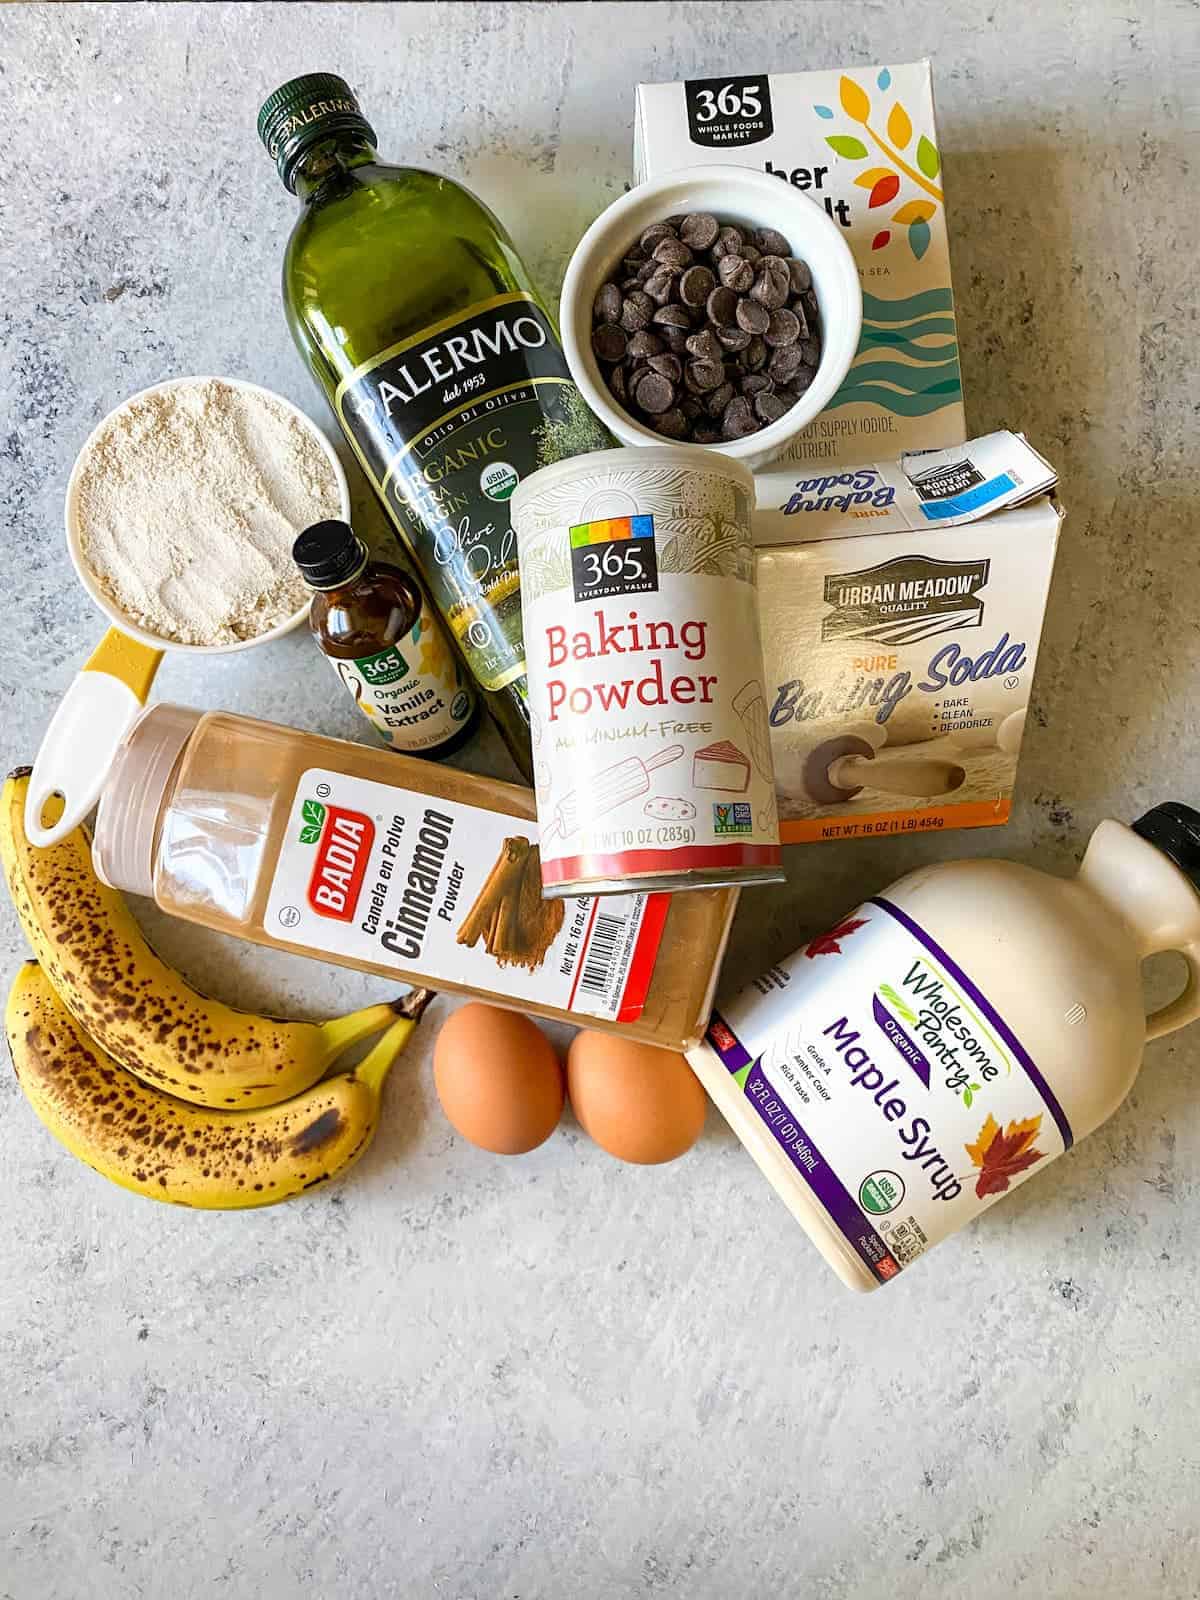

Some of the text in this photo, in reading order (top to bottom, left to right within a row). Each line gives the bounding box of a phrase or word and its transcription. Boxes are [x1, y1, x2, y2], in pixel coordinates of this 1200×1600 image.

[696, 84, 762, 122] 365
[697, 121, 764, 134] WHOLE FOODS
[712, 130, 751, 141] MARKET
[765, 161, 828, 190] her
[824, 197, 851, 227] lt
[443, 373, 486, 404] dal 1953
[820, 420, 858, 438] SUPPLY
[486, 468, 509, 485] USDA
[796, 470, 879, 495] Soda
[922, 470, 971, 490] MEADOW
[931, 479, 971, 497] URBAN
[779, 486, 896, 515] Baking
[434, 516, 496, 565] Olive
[463, 529, 514, 584] Oil
[579, 582, 653, 598] EVERYDAY VALUE
[839, 582, 896, 607] URBAN
[879, 601, 929, 614] QUALITY
[546, 611, 708, 668] Baking
[363, 654, 400, 677] 365
[852, 654, 898, 672] PURE
[917, 632, 1027, 692] Soda
[374, 680, 420, 699] Organic
[376, 688, 435, 715] Vanilla
[546, 659, 718, 722] Powder
[943, 698, 969, 708] BAKE
[384, 698, 445, 727] Extract
[940, 718, 993, 732] DEODORIZE
[941, 709, 973, 720] CLEAN
[622, 831, 633, 846] 10
[639, 829, 652, 843] OZ
[656, 826, 696, 845] (283g)
[822, 826, 840, 837] NET
[843, 825, 858, 835] WT
[863, 824, 873, 833] 16
[875, 822, 889, 832] OZ
[920, 817, 944, 827] 454g
[315, 817, 365, 913] BADIA
[361, 815, 406, 936] Canela en Polvo
[381, 808, 455, 960] Cinnamon
[438, 861, 465, 922] Powder
[560, 958, 574, 976] Net
[570, 926, 582, 939] 16
[902, 961, 999, 1082] Wholesome
[883, 1020, 922, 1066] Organic
[914, 1009, 971, 1089] Pantry
[807, 1045, 832, 1076] Grade A
[822, 1016, 906, 1122] Maple
[780, 1064, 811, 1104] Rich Taste
[794, 1055, 832, 1102] Amber Color
[749, 1078, 765, 1094] 32
[757, 1089, 770, 1104] FL
[765, 1100, 782, 1117] OZ
[791, 1138, 819, 1174] 946mL
[899, 1117, 962, 1201] Syrup
[878, 1177, 897, 1200] USDA
